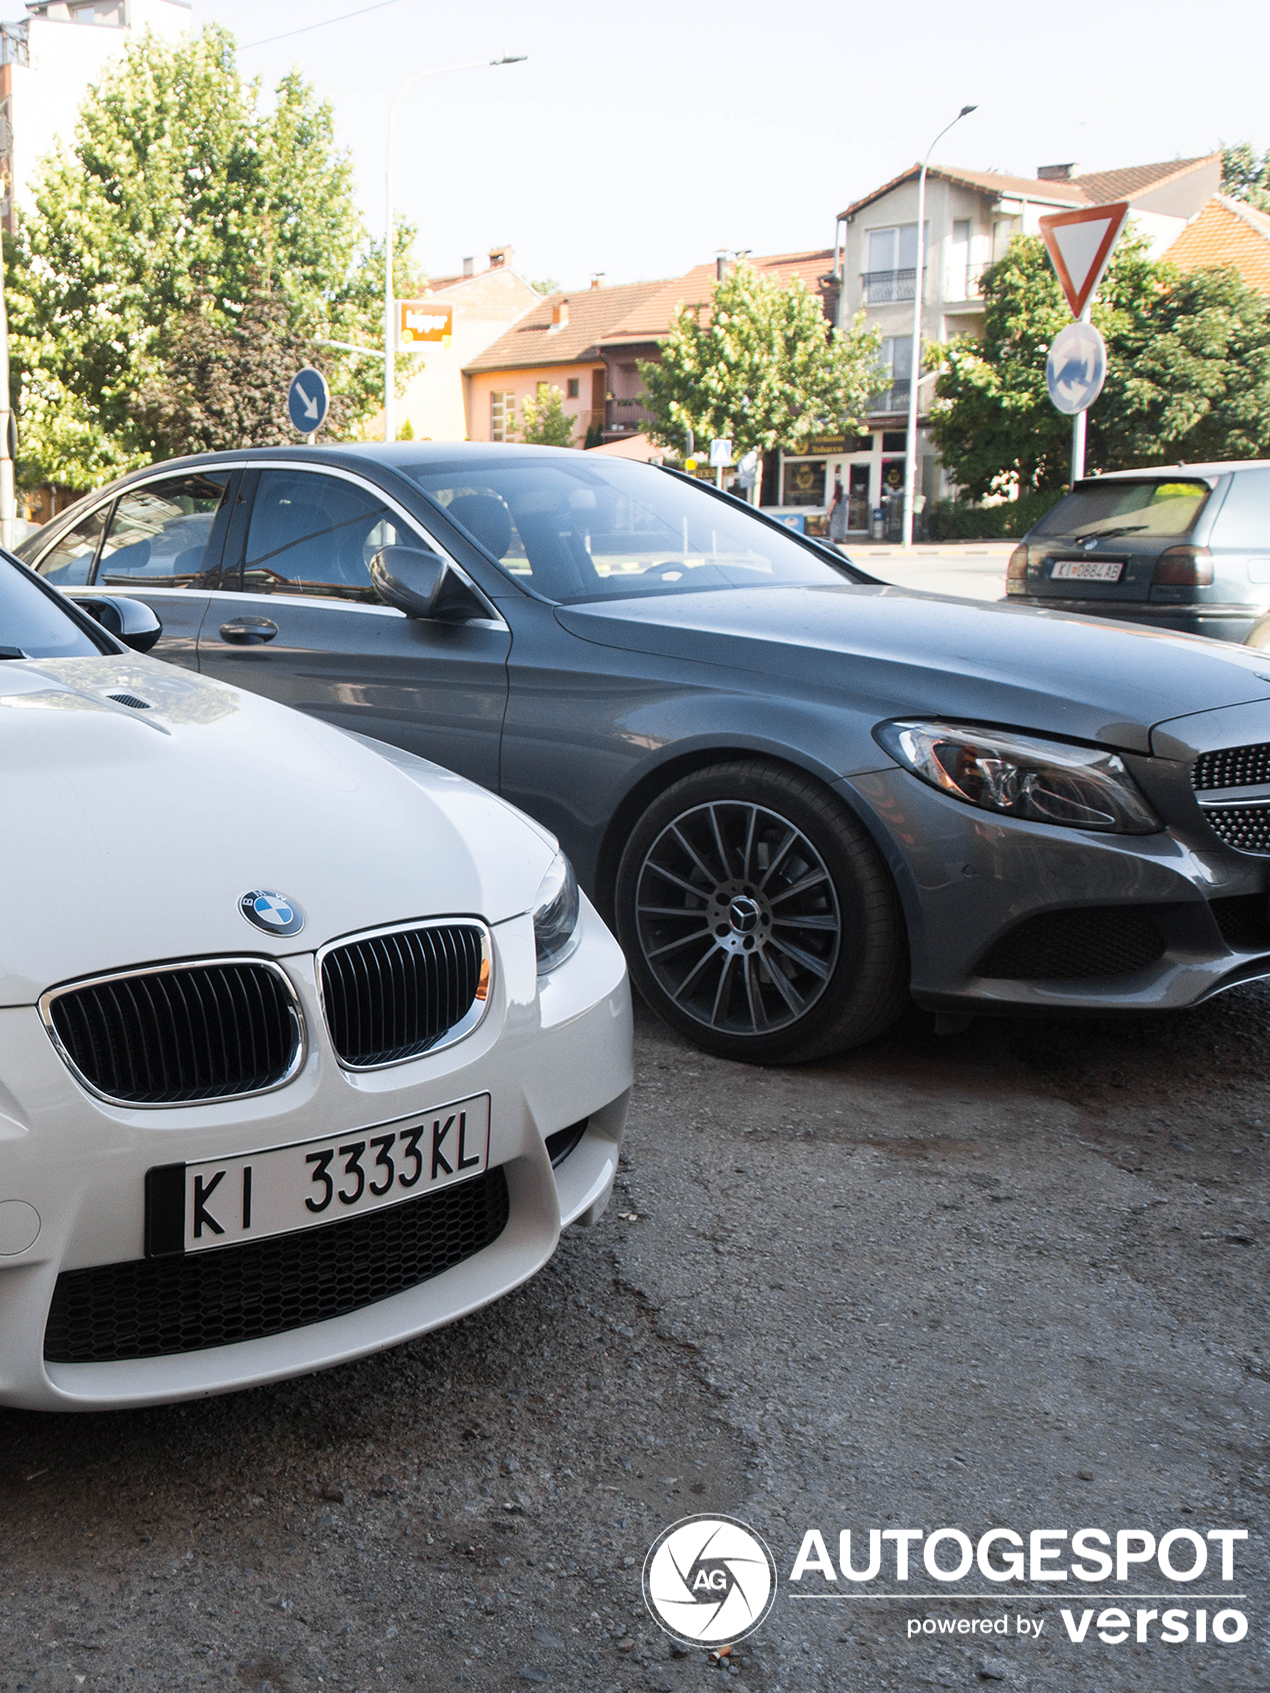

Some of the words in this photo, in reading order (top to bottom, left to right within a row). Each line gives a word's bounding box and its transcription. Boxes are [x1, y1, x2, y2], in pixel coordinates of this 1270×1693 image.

[242, 889, 287, 906] BMW
[193, 1166, 253, 1238] KI
[304, 1110, 480, 1213] 3333KL
